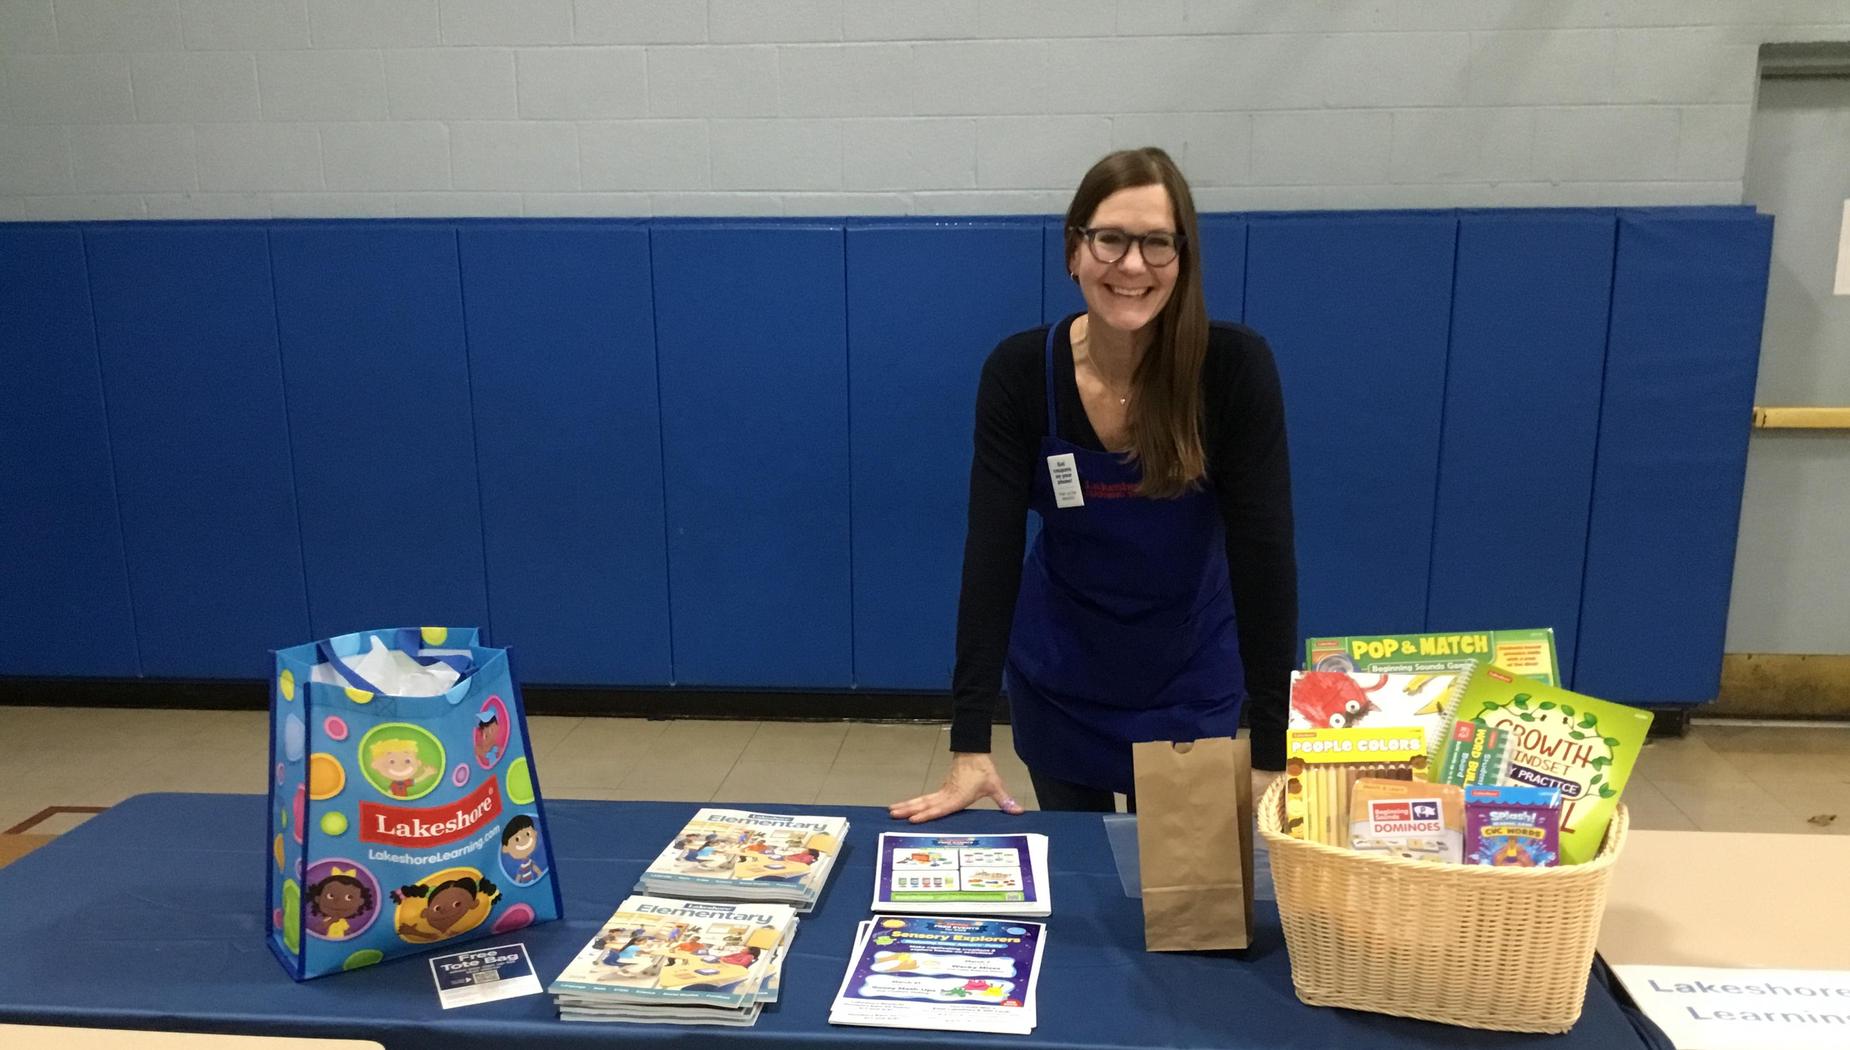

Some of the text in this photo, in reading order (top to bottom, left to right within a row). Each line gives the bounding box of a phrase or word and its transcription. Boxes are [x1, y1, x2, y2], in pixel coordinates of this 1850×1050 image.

[1351, 635, 1489, 660] POP & MATCH
[1371, 663, 1413, 673] Beginning
[1414, 662, 1445, 671] Sounds
[1292, 738, 1420, 753] PEOPLE COLORS
[1462, 729, 1487, 789] WORD BUIL
[1513, 750, 1574, 776] INDSET
[1518, 769, 1580, 795] PRACTICE
[375, 797, 493, 838] Lakeshore
[707, 814, 828, 832] Elementary
[1488, 810, 1537, 823] Splash!
[1374, 822, 1441, 833] DOMINOES
[1484, 828, 1542, 837] CVC WORDS
[369, 825, 501, 865] LakeshoreLearning.com
[636, 904, 775, 925] Elementary
[891, 931, 950, 941] Sensory
[953, 934, 1022, 943] Explorers
[440, 960, 480, 971] Tote
[484, 953, 519, 964] Bag
[458, 951, 498, 962] Free
[1647, 979, 1850, 998] Lakeshore
[1686, 1006, 1850, 1025] Learnin
